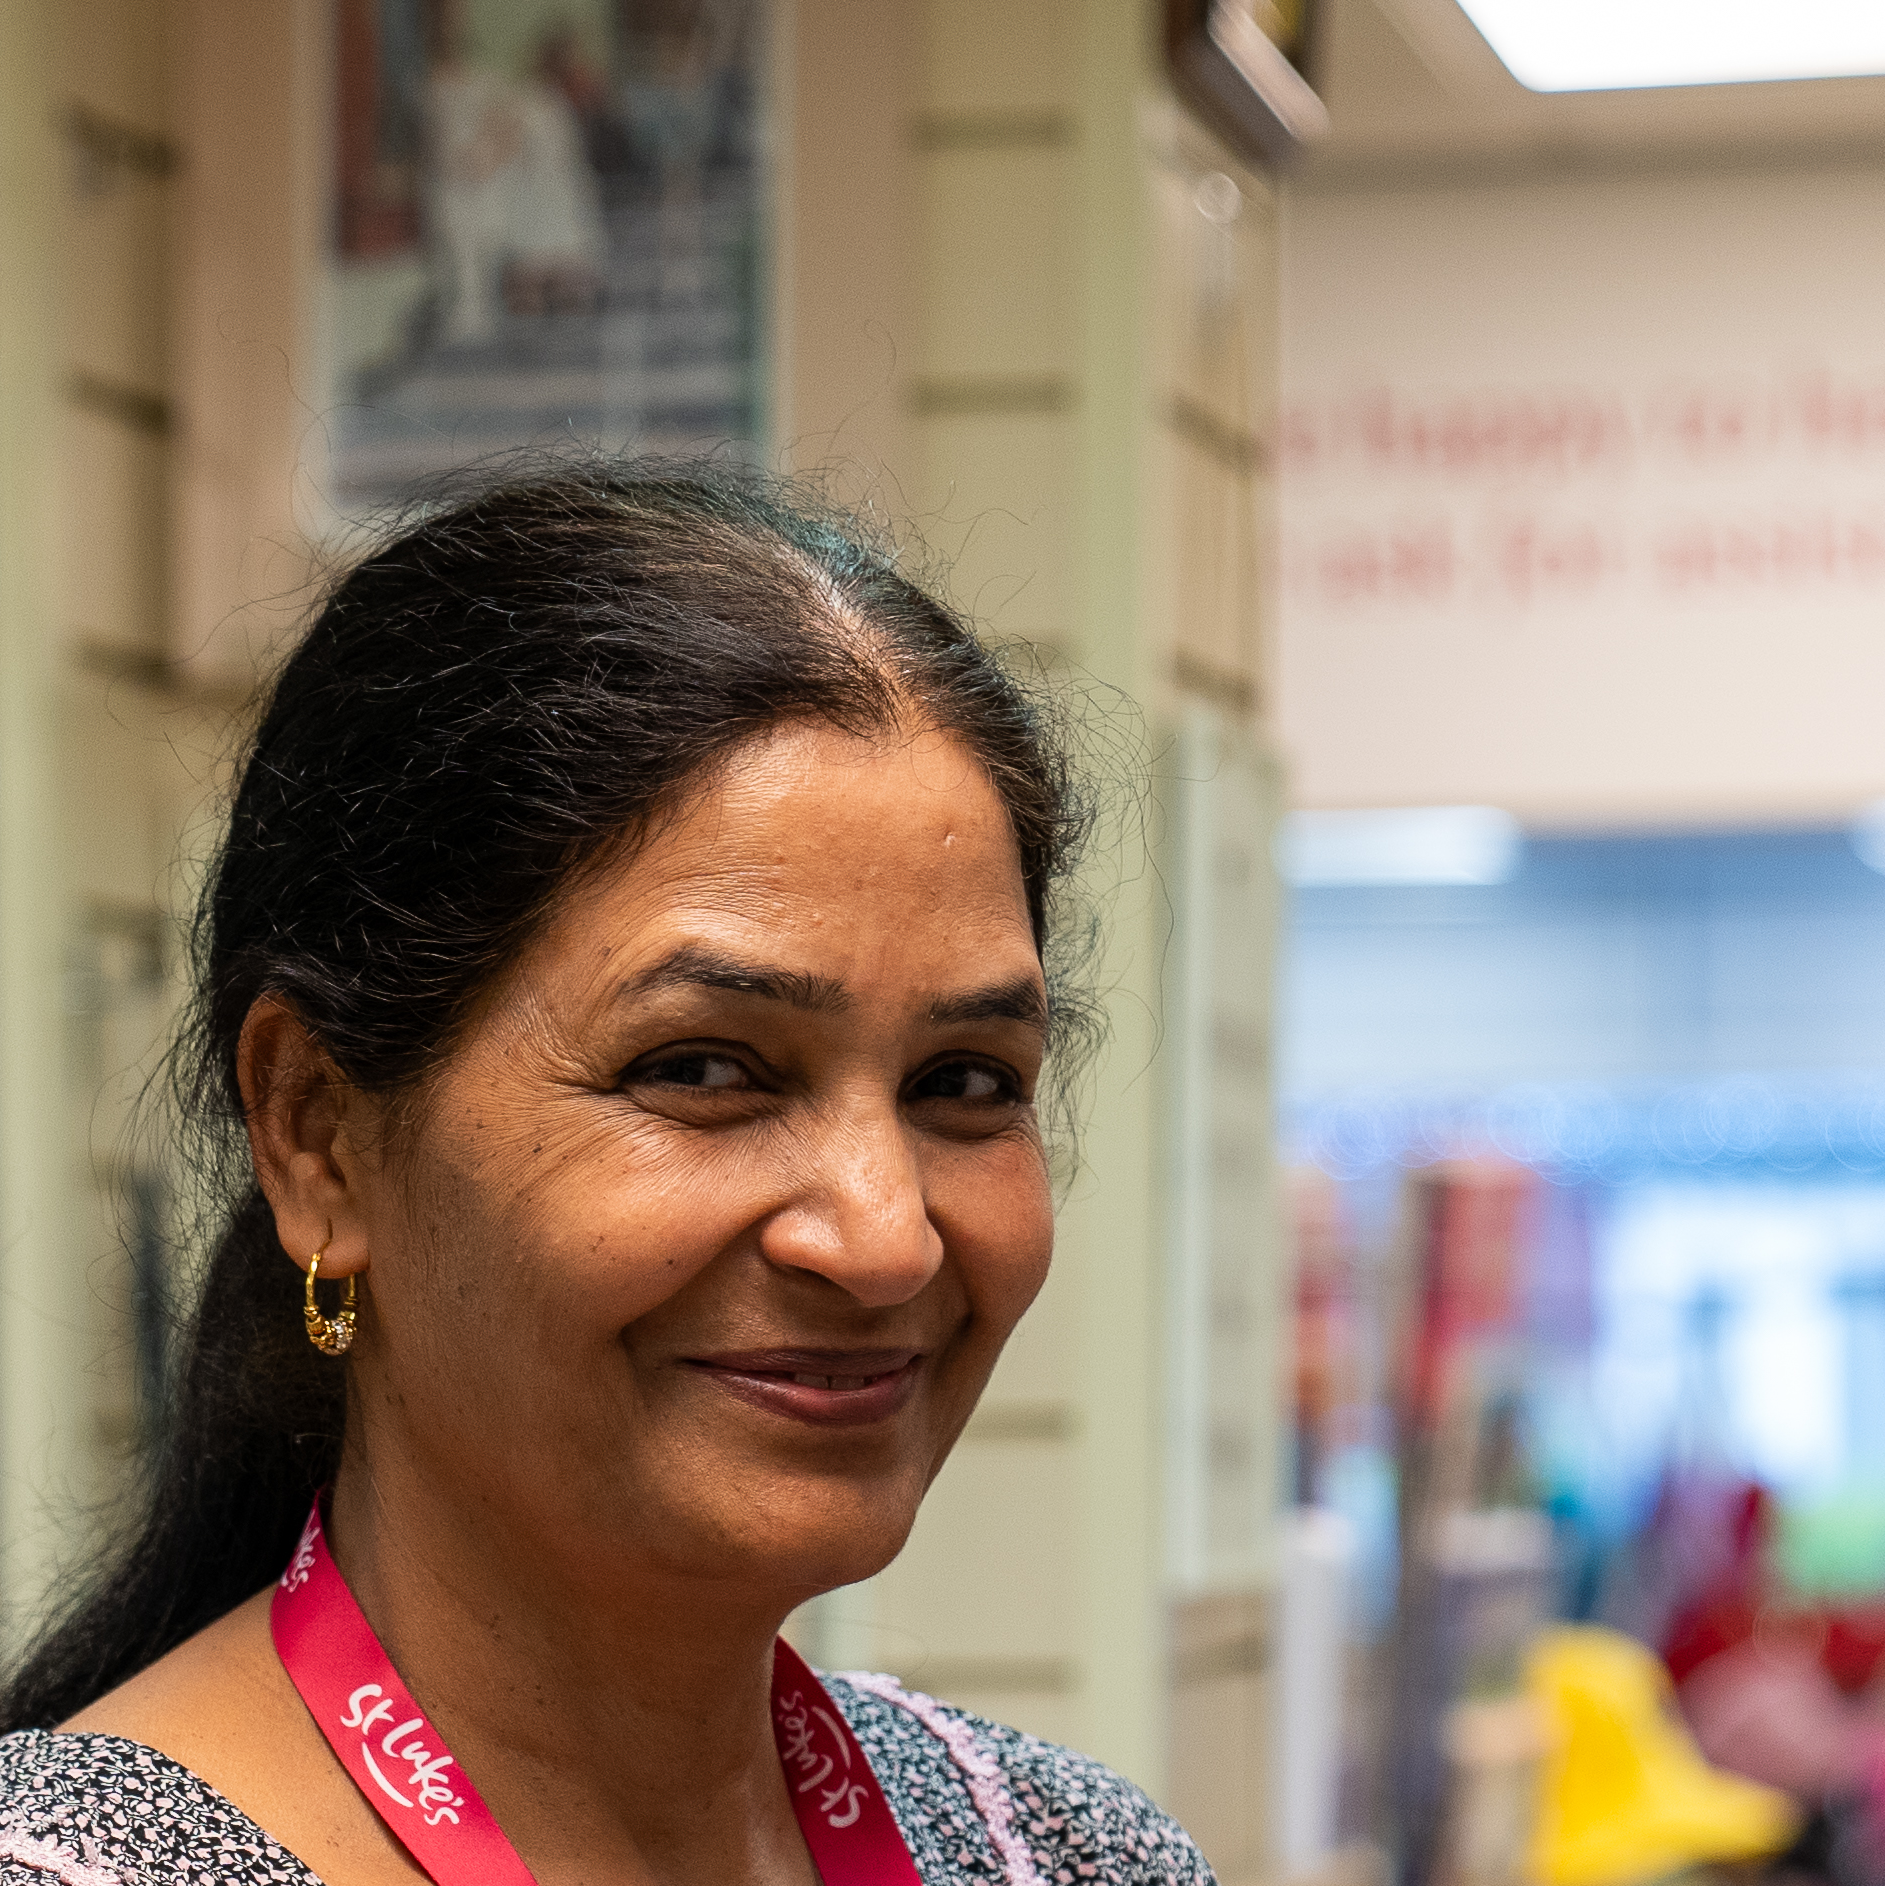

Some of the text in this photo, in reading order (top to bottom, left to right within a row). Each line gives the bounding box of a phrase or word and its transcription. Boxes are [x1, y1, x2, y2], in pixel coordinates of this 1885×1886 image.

[340, 1684, 464, 1826] St Luke's
[820, 1778, 869, 1828] St
